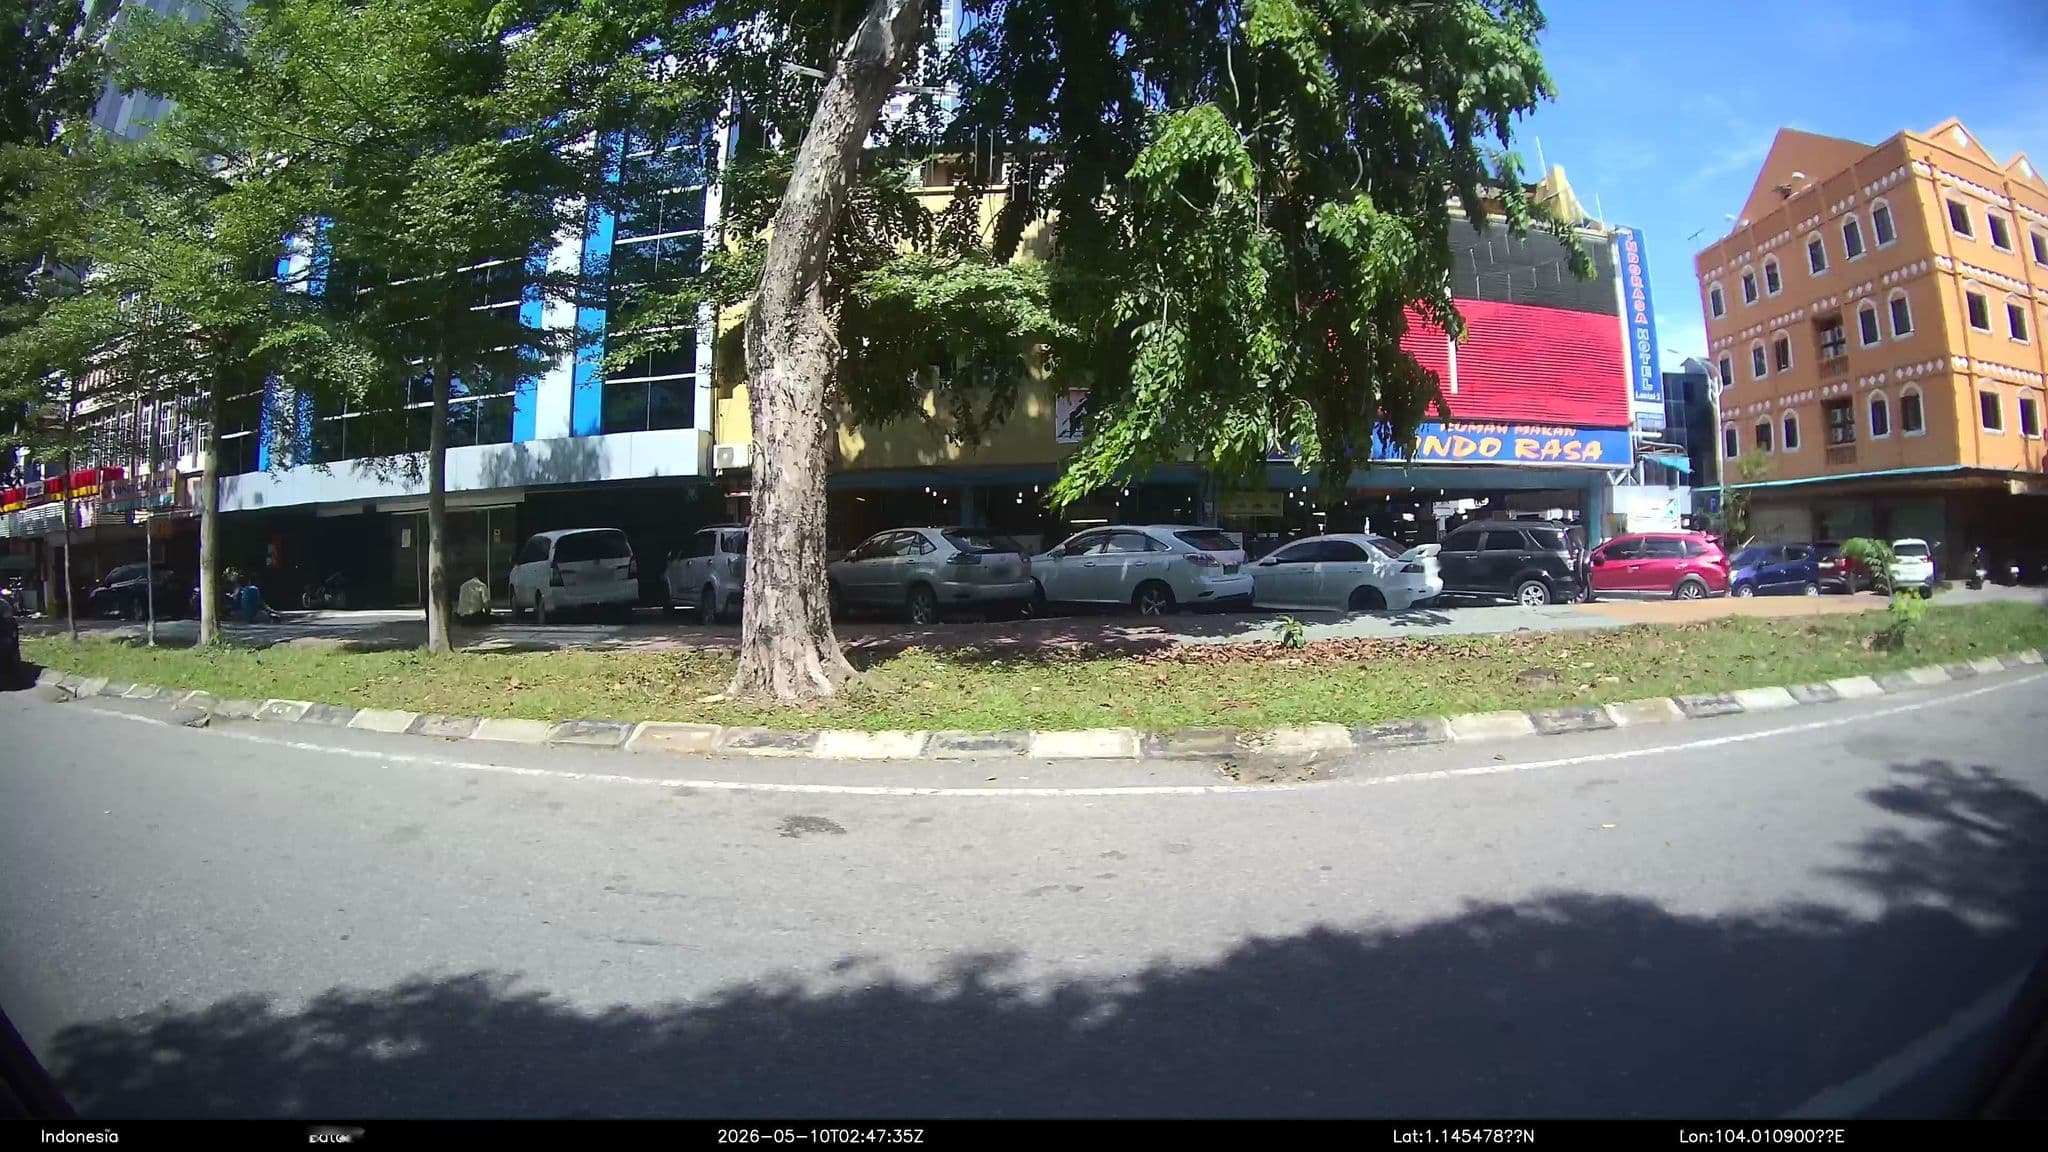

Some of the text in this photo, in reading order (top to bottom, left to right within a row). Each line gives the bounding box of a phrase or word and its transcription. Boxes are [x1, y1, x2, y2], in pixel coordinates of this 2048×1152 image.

[1637, 327, 1653, 391] HOTEL
[1514, 425, 1577, 436] MAKAN
[1515, 438, 1603, 461] RASA
